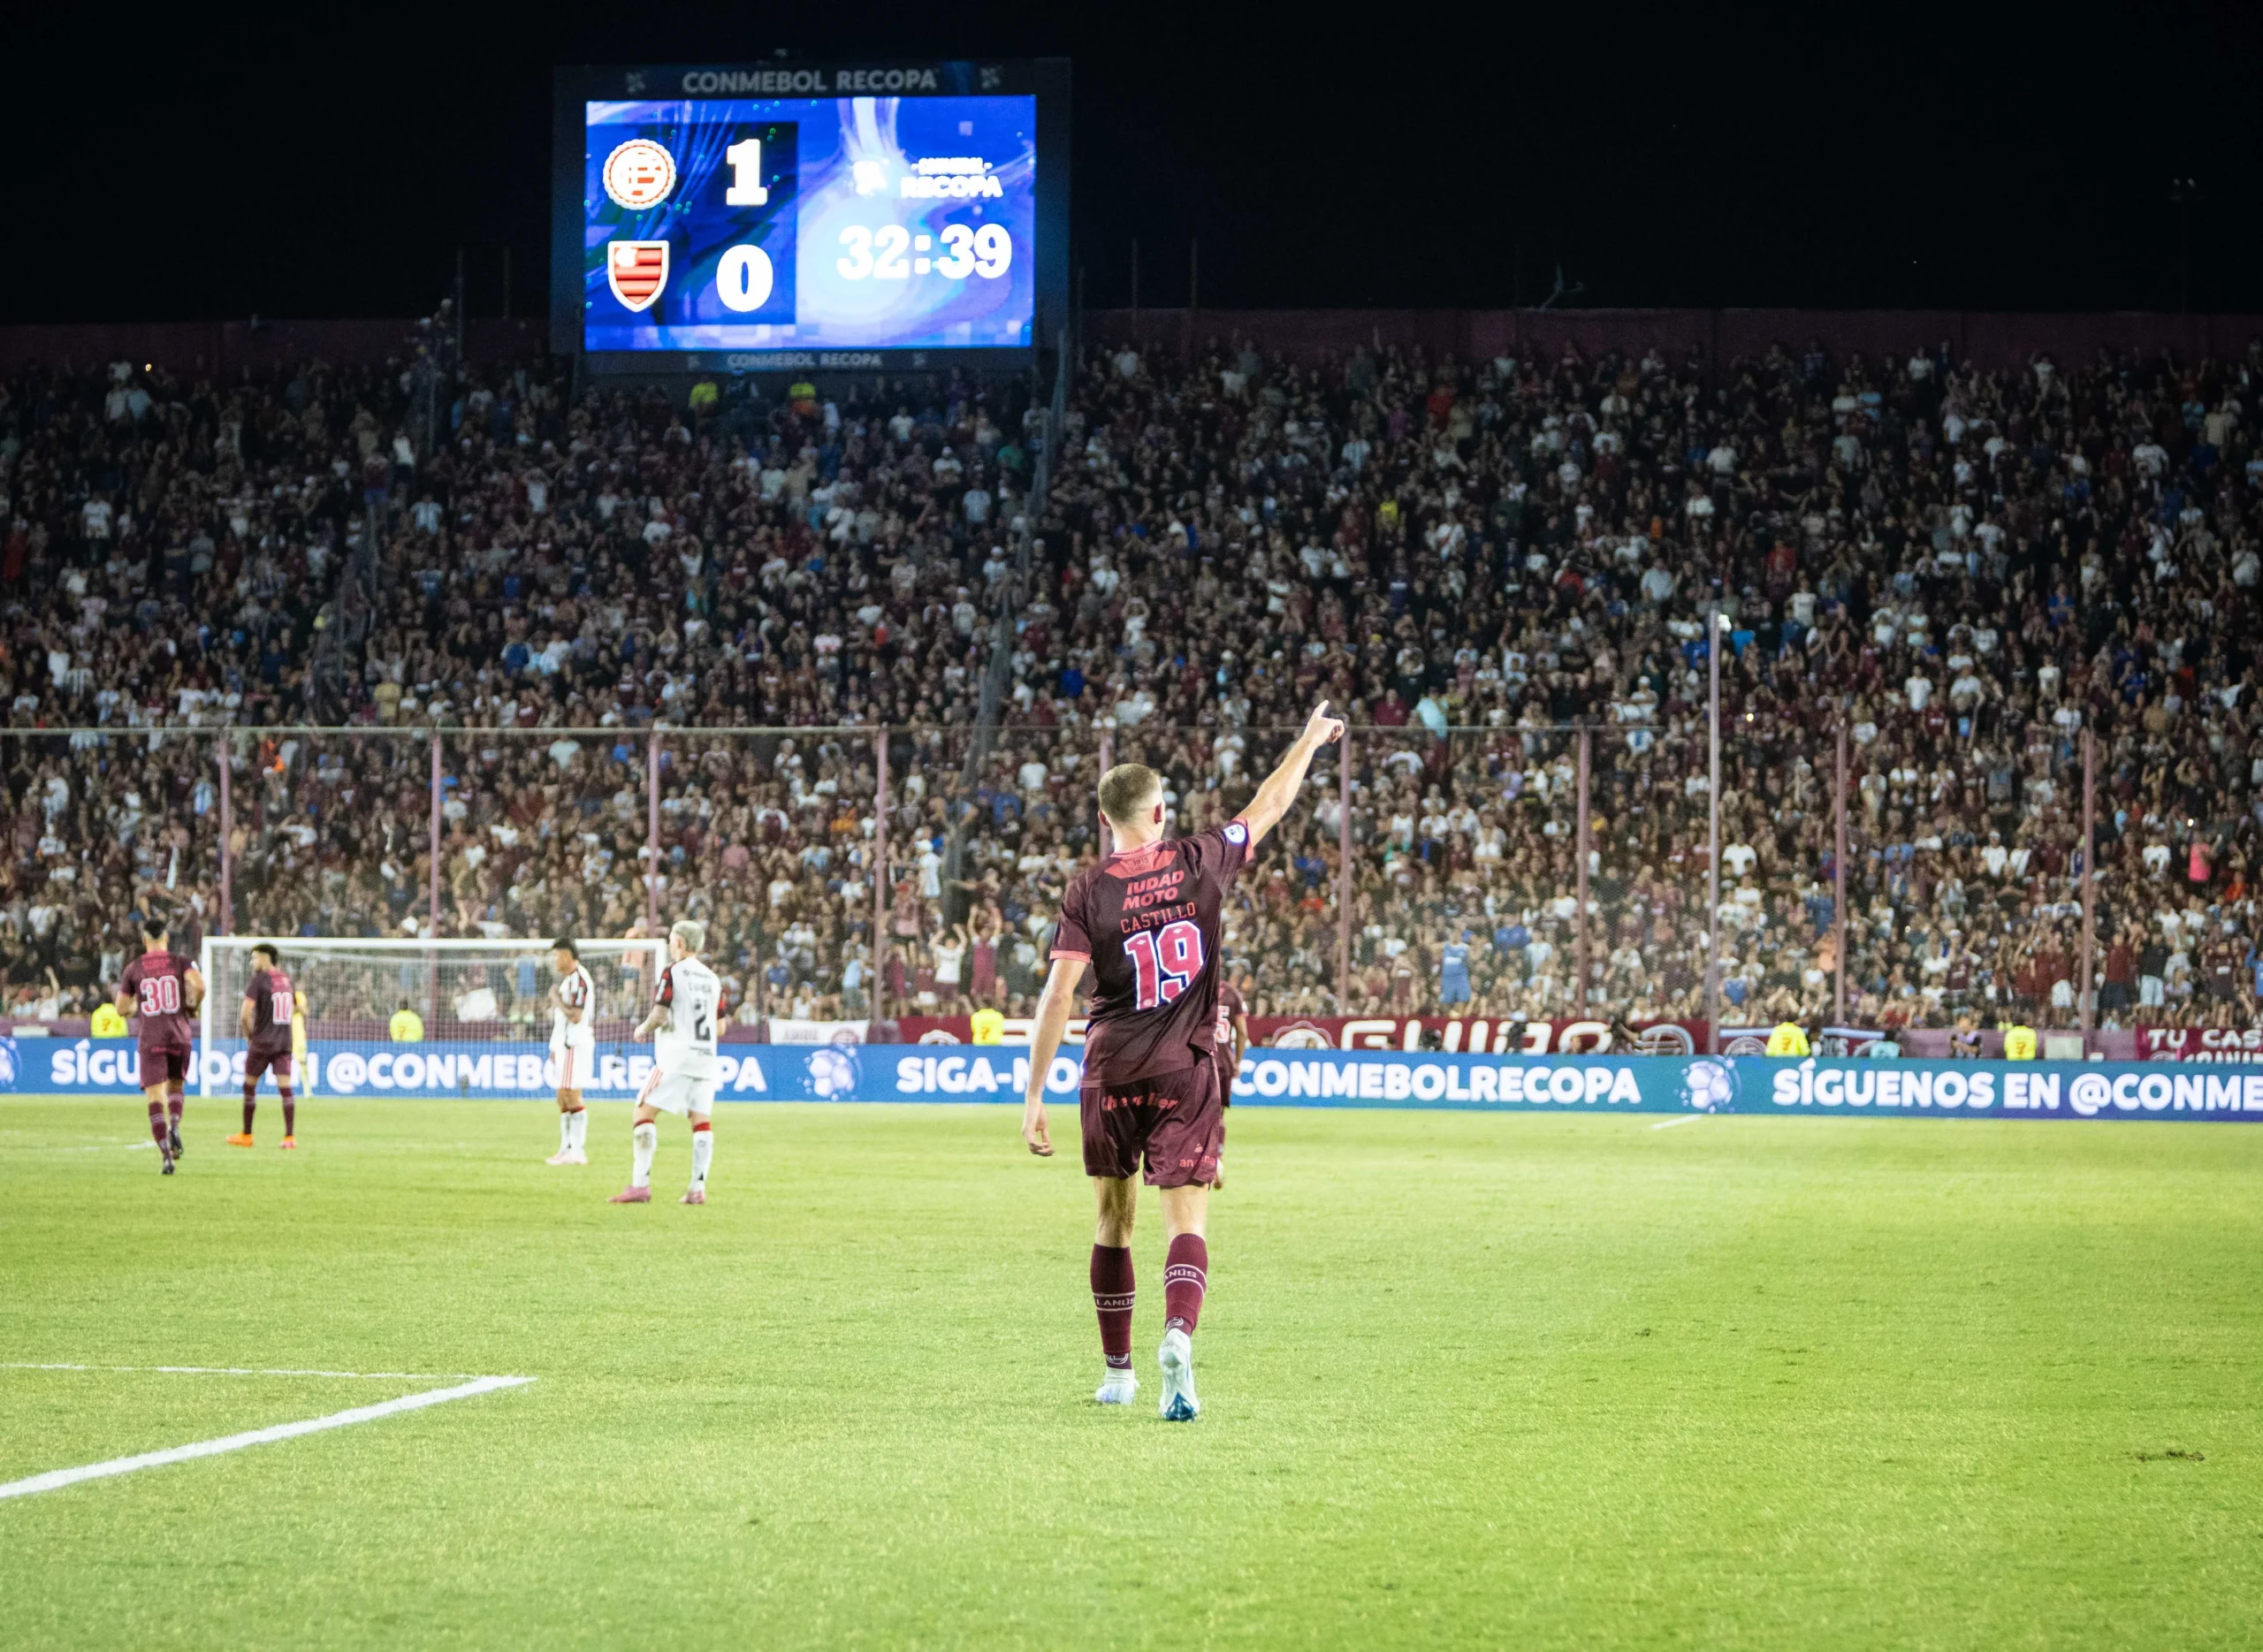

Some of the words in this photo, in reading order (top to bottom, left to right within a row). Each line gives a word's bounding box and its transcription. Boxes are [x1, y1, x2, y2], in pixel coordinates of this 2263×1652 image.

[682, 71, 828, 93] CONMEBOL
[836, 68, 938, 90] RECOPA
[726, 139, 768, 206] 1
[836, 223, 1012, 280] 32:39
[716, 244, 773, 313] 0
[727, 352, 816, 369] CONMEBOL
[819, 352, 882, 368] RECOPA
[1120, 902, 1196, 933] CASTILLO
[1123, 887, 1178, 911] MOTO
[1123, 920, 1203, 1010] 19
[140, 975, 180, 1017] 30
[271, 991, 293, 1025] 10
[693, 999, 711, 1041] 2
[2147, 1029, 2188, 1051] TU
[1772, 1057, 1995, 1109] SÍGUENOS
[2003, 1072, 2061, 1110] EN
[2069, 1072, 2263, 1115] @CONME
